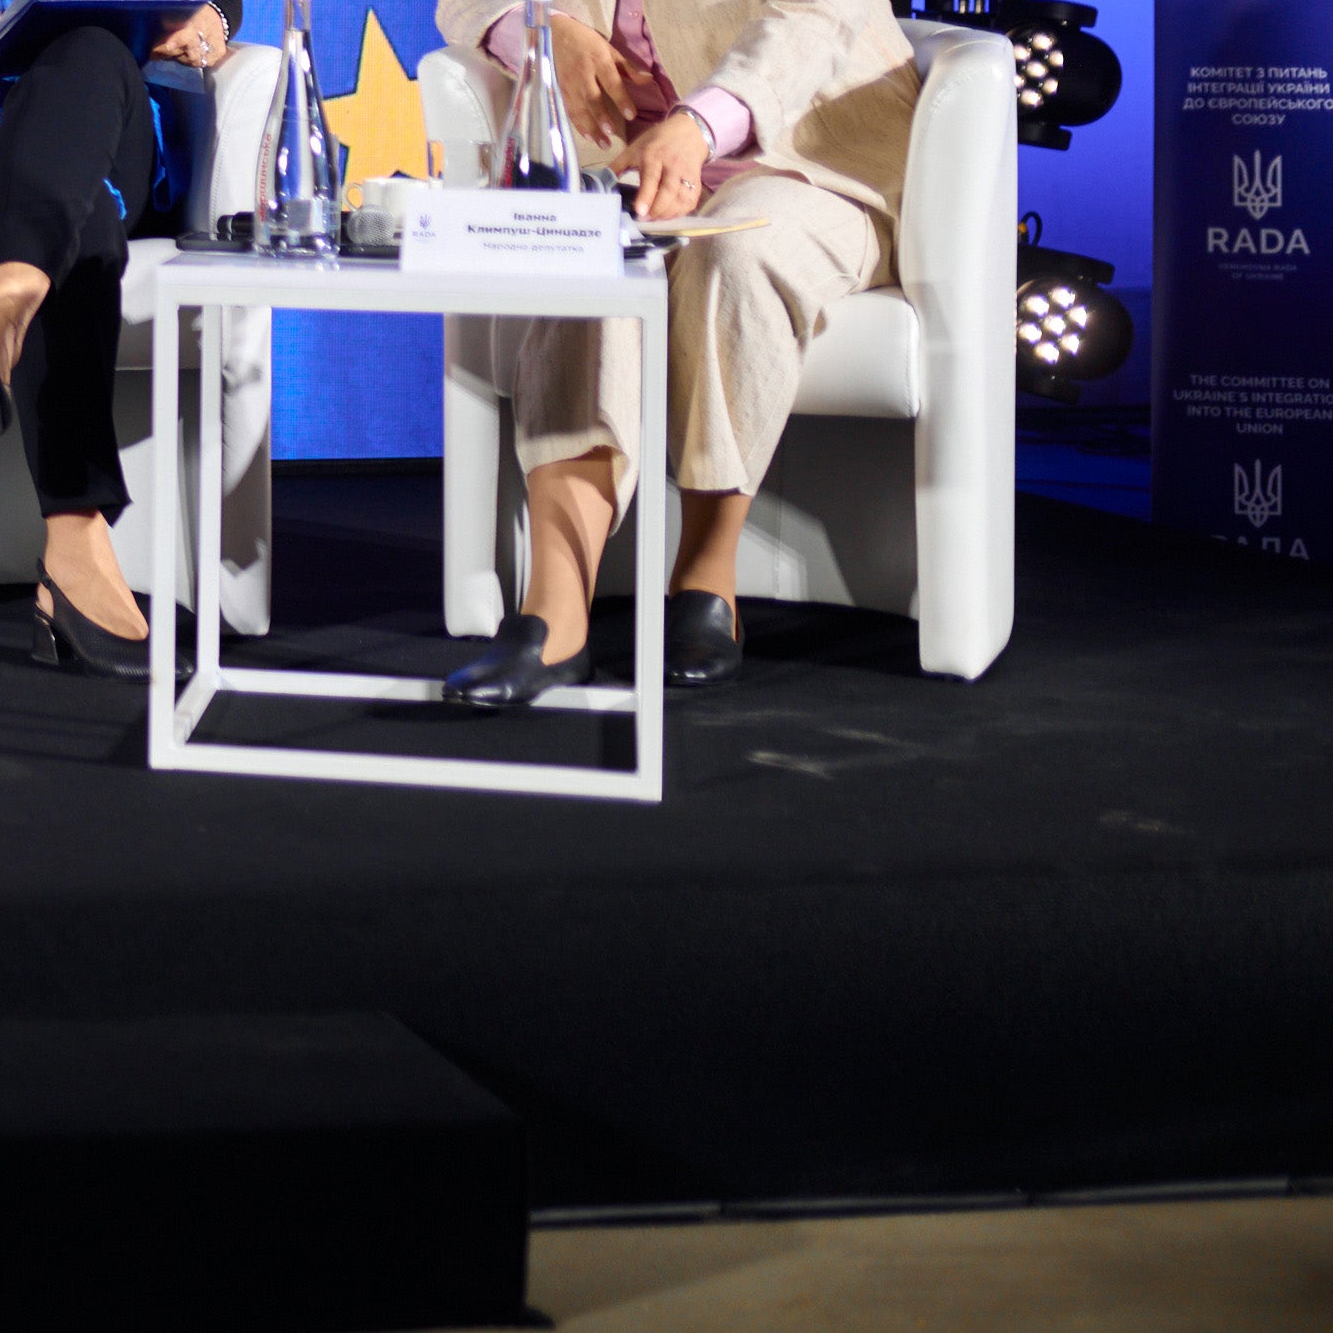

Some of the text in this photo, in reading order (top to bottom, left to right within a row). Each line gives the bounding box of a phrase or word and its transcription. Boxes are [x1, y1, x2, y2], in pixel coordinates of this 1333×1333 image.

[1190, 67, 1328, 79] КОМІТЕТ З ПИТАНЬ
[1187, 81, 1330, 94] ІНТЕГРАЦІЇ УКРАЇНИ
[1183, 98, 1205, 110] ДО
[1232, 114, 1286, 125] СОЮЗУ
[513, 212, 557, 222] Іванна
[1207, 227, 1311, 255] RADA
[1190, 374, 1330, 389] THE COMMITTEE ON
[1187, 404, 1333, 420] INTO THE EUROPEAN
[1235, 422, 1283, 435] UNION
